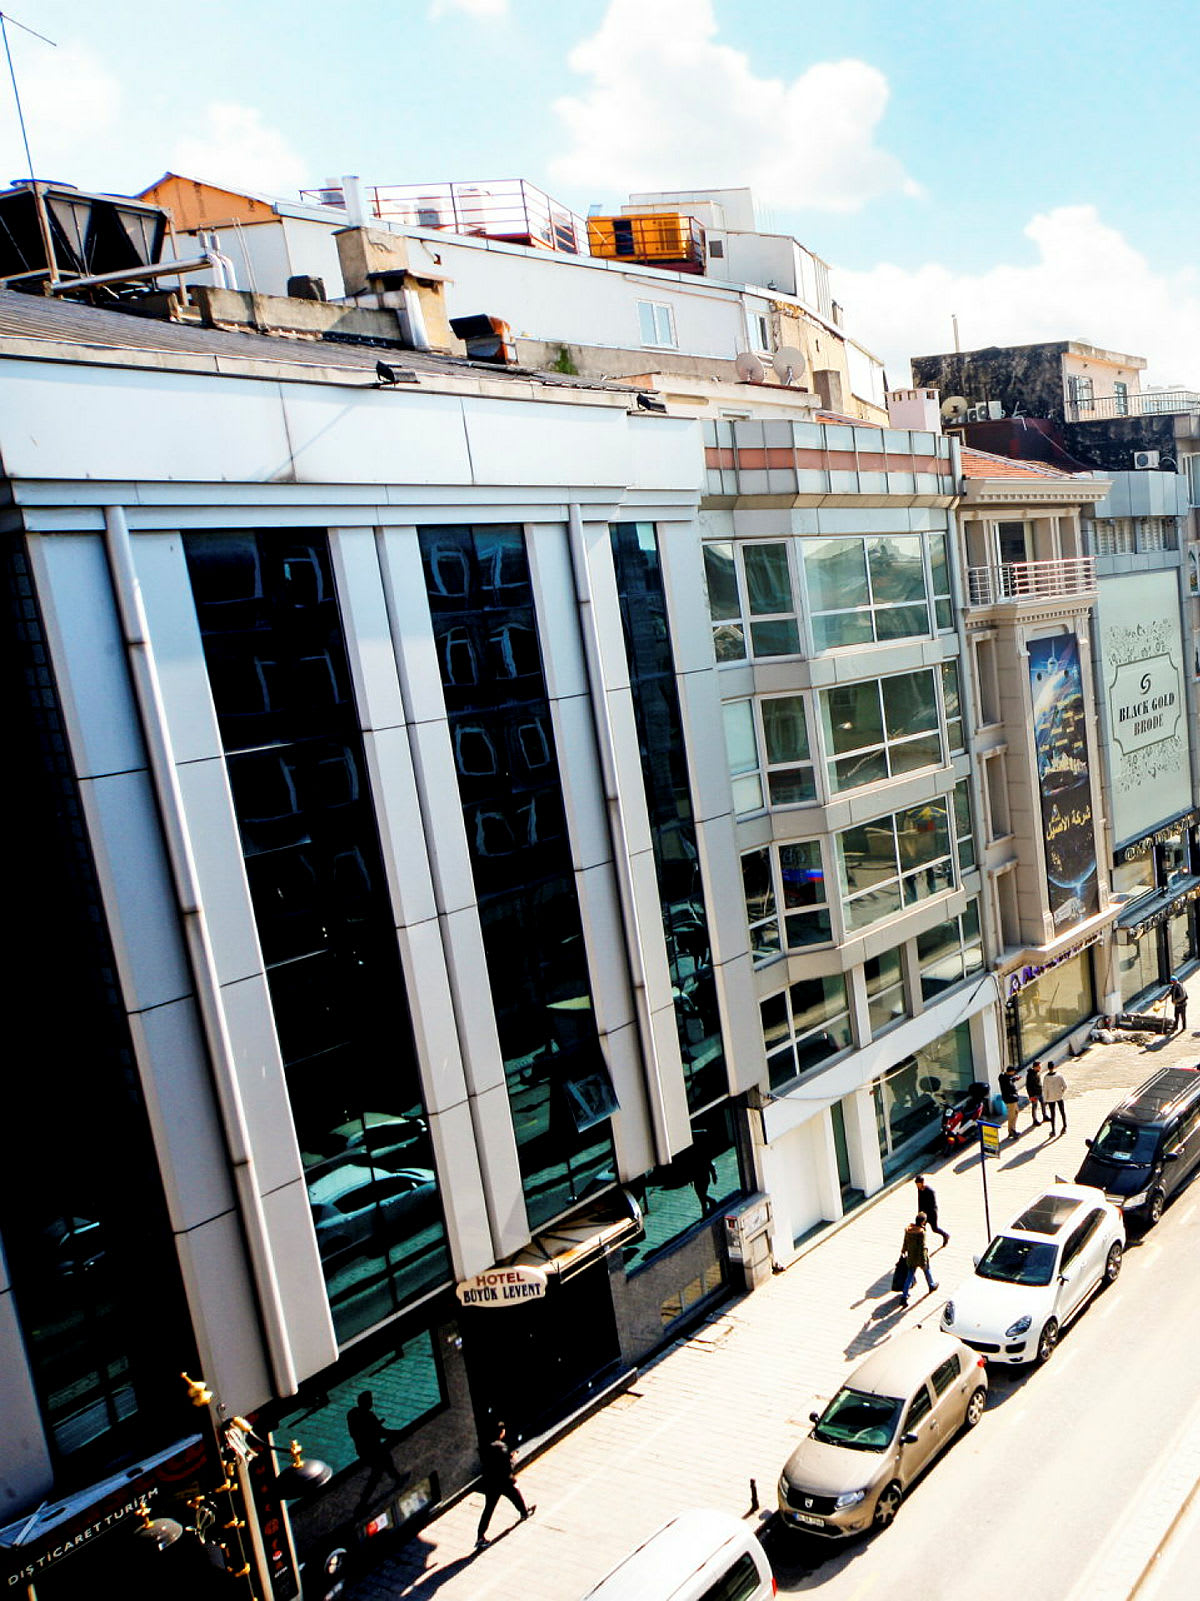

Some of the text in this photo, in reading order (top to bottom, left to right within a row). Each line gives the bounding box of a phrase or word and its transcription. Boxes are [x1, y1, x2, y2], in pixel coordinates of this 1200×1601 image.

[1119, 692, 1175, 723] BLACK GOLD
[1133, 713, 1164, 736] BRODE
[476, 1272, 525, 1287] HOTEL
[463, 1283, 541, 1304] BÜYÜK LEVENT
[104, 1487, 159, 1526] TURİZM
